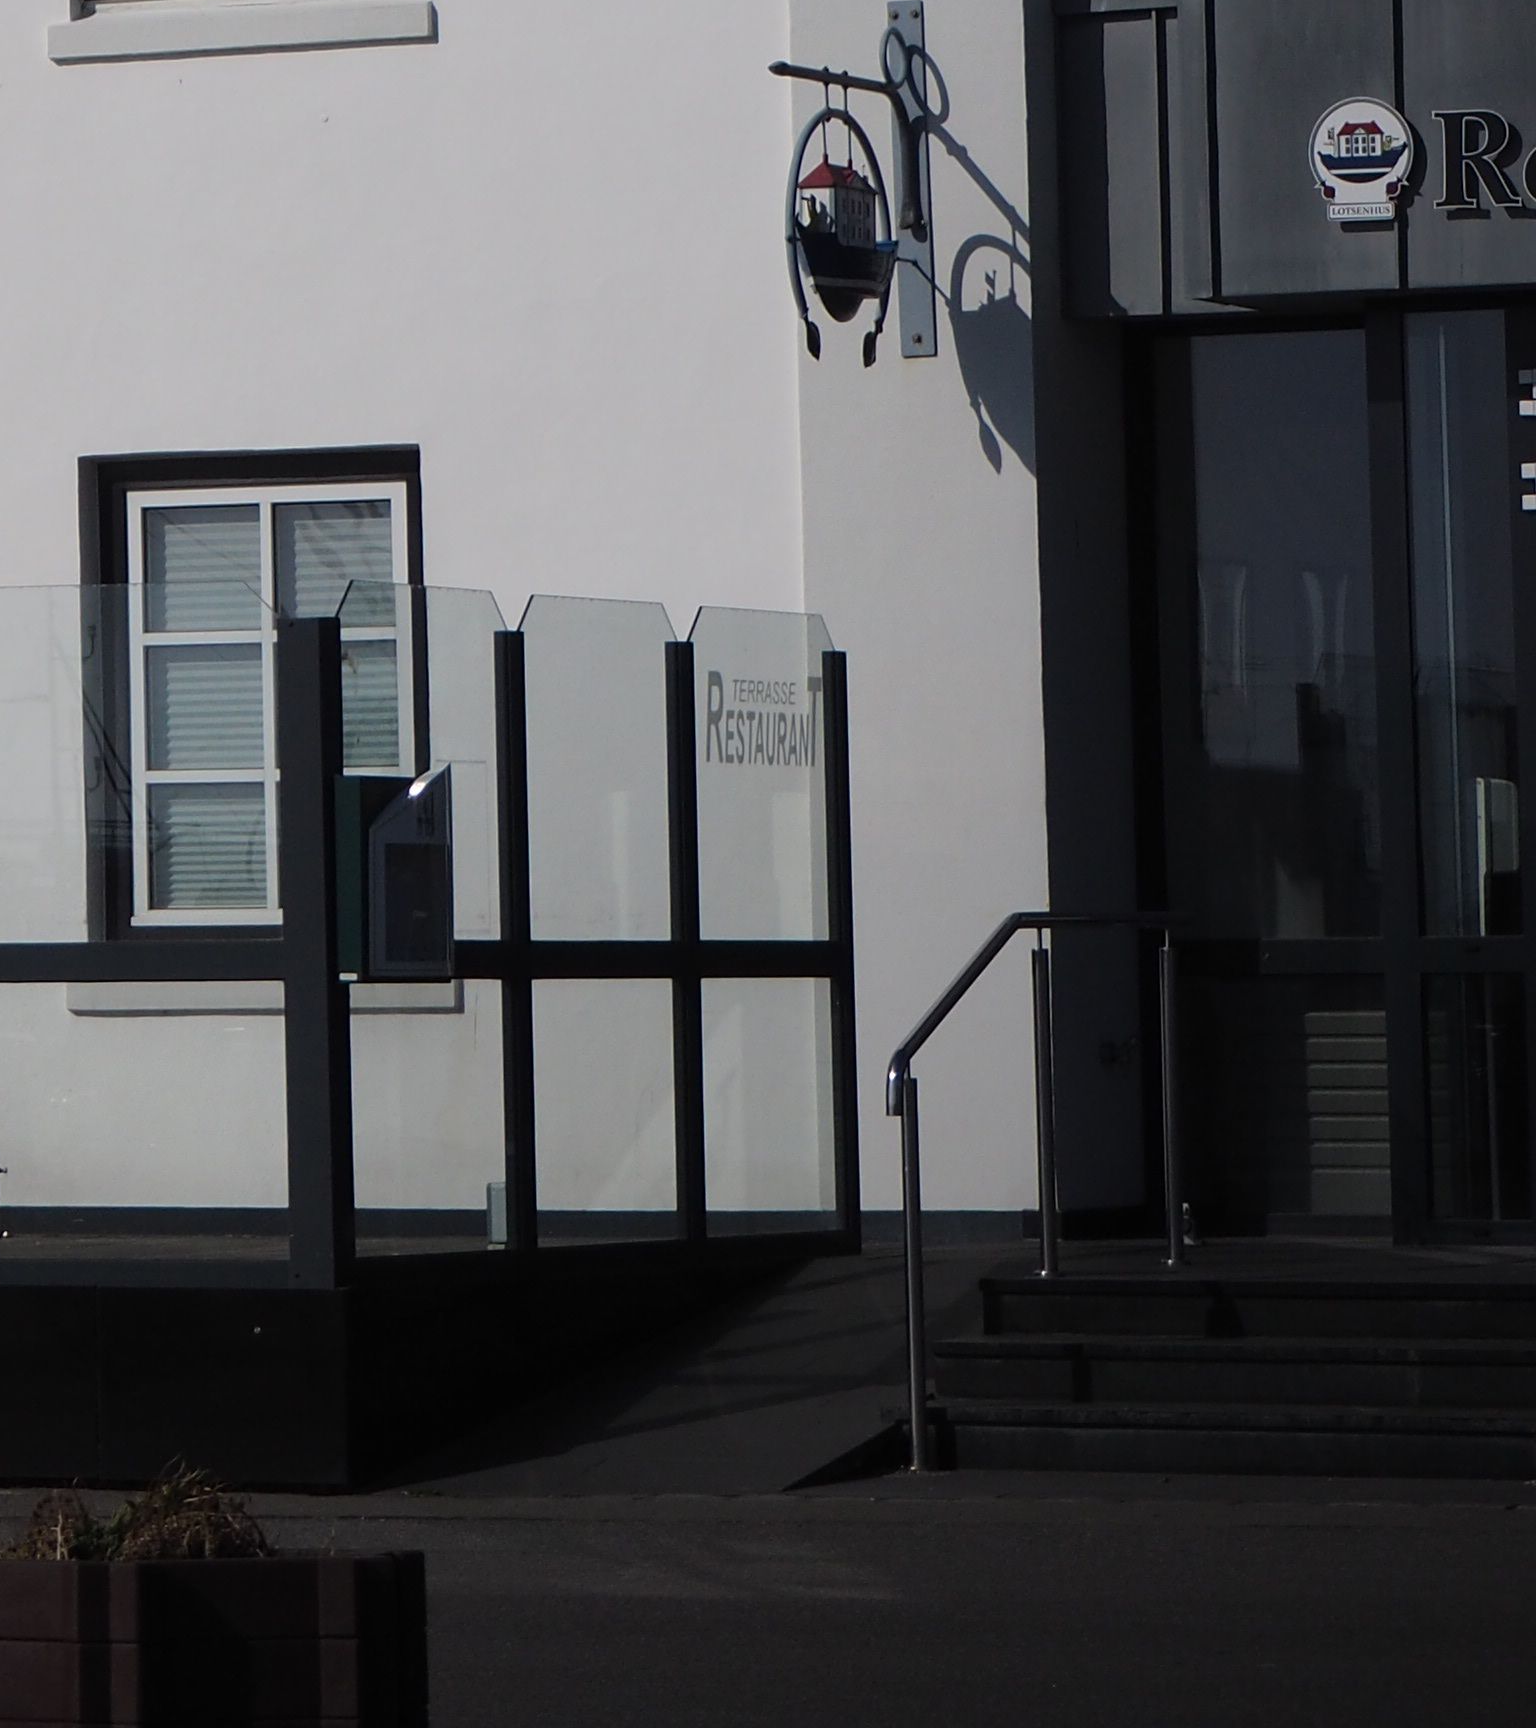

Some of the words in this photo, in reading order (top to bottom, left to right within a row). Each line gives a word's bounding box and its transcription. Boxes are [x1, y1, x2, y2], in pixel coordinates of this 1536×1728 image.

[1431, 109, 1536, 209] R
[1332, 205, 1391, 217] LOTSENHUS
[706, 670, 822, 767] RESTAURANT
[733, 679, 797, 705] TERRASSE
